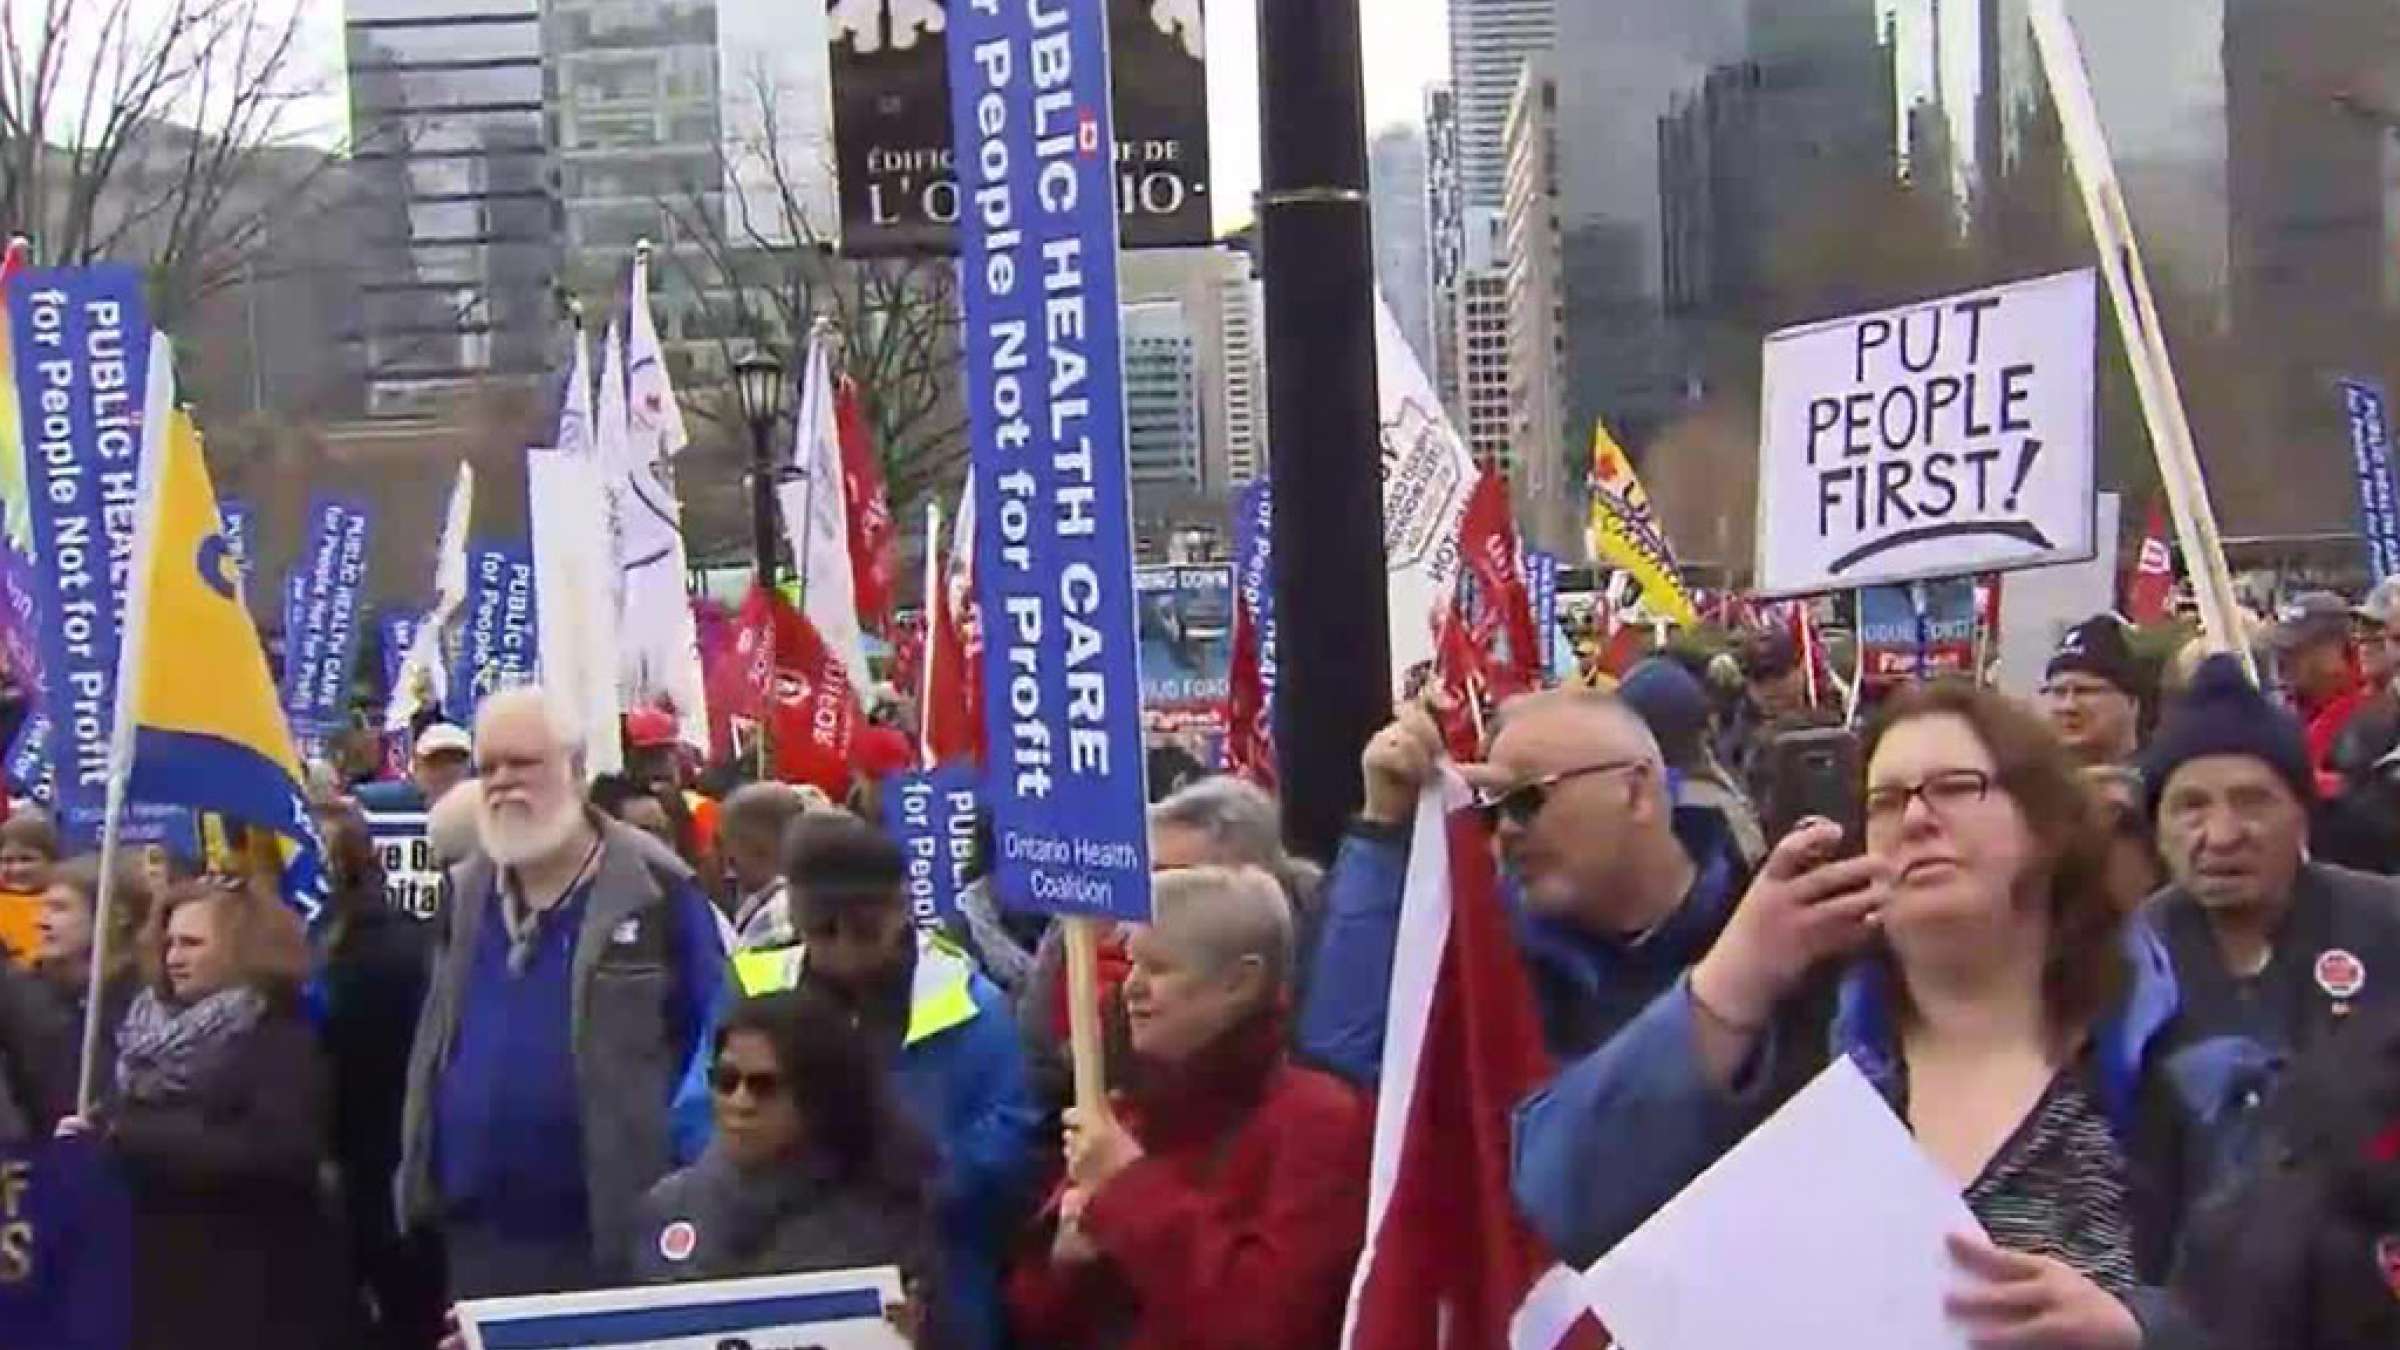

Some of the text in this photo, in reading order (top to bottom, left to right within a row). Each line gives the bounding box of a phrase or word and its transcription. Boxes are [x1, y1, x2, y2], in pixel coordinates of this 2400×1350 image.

[974, 37, 1022, 296] People
[1145, 140, 1180, 160] DE
[83, 301, 133, 459] PUBLIC
[989, 319, 1031, 450] Not
[1042, 237, 1095, 536] HEALTH
[1855, 297, 2001, 382] PUT
[1806, 363, 2035, 465] PEOPLE
[29, 289, 109, 787] for People Not for Profit
[998, 468, 1036, 572] for
[1816, 438, 2043, 537] FIRST!
[1005, 596, 1051, 799] Profit
[1060, 562, 1111, 776] CARE
[901, 781, 933, 827] for
[1004, 831, 1138, 869] Ontario Health
[1029, 868, 1113, 907] Coalition
